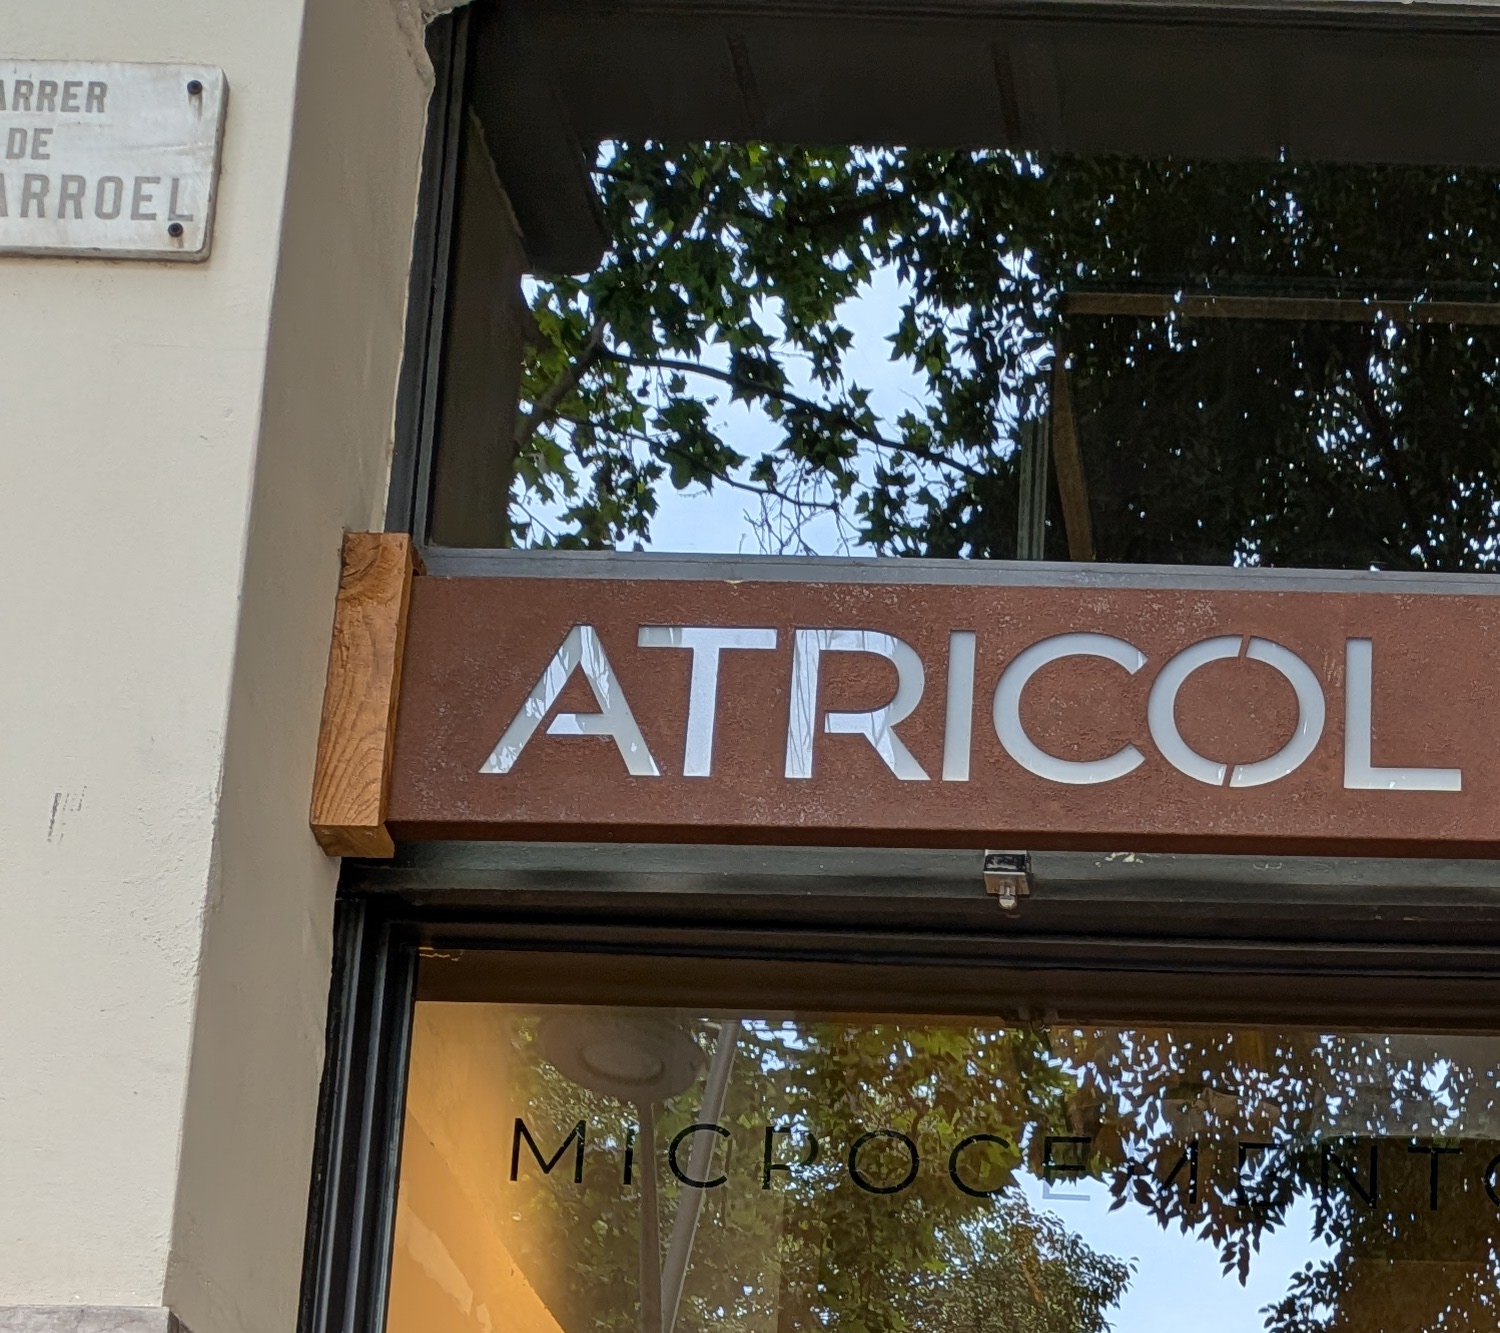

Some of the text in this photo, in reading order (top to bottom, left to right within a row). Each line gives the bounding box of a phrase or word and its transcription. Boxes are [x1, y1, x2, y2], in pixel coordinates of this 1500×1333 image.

[0, 79, 108, 114] RRER
[5, 127, 54, 161] DE
[478, 624, 1462, 791] ATRICOL
